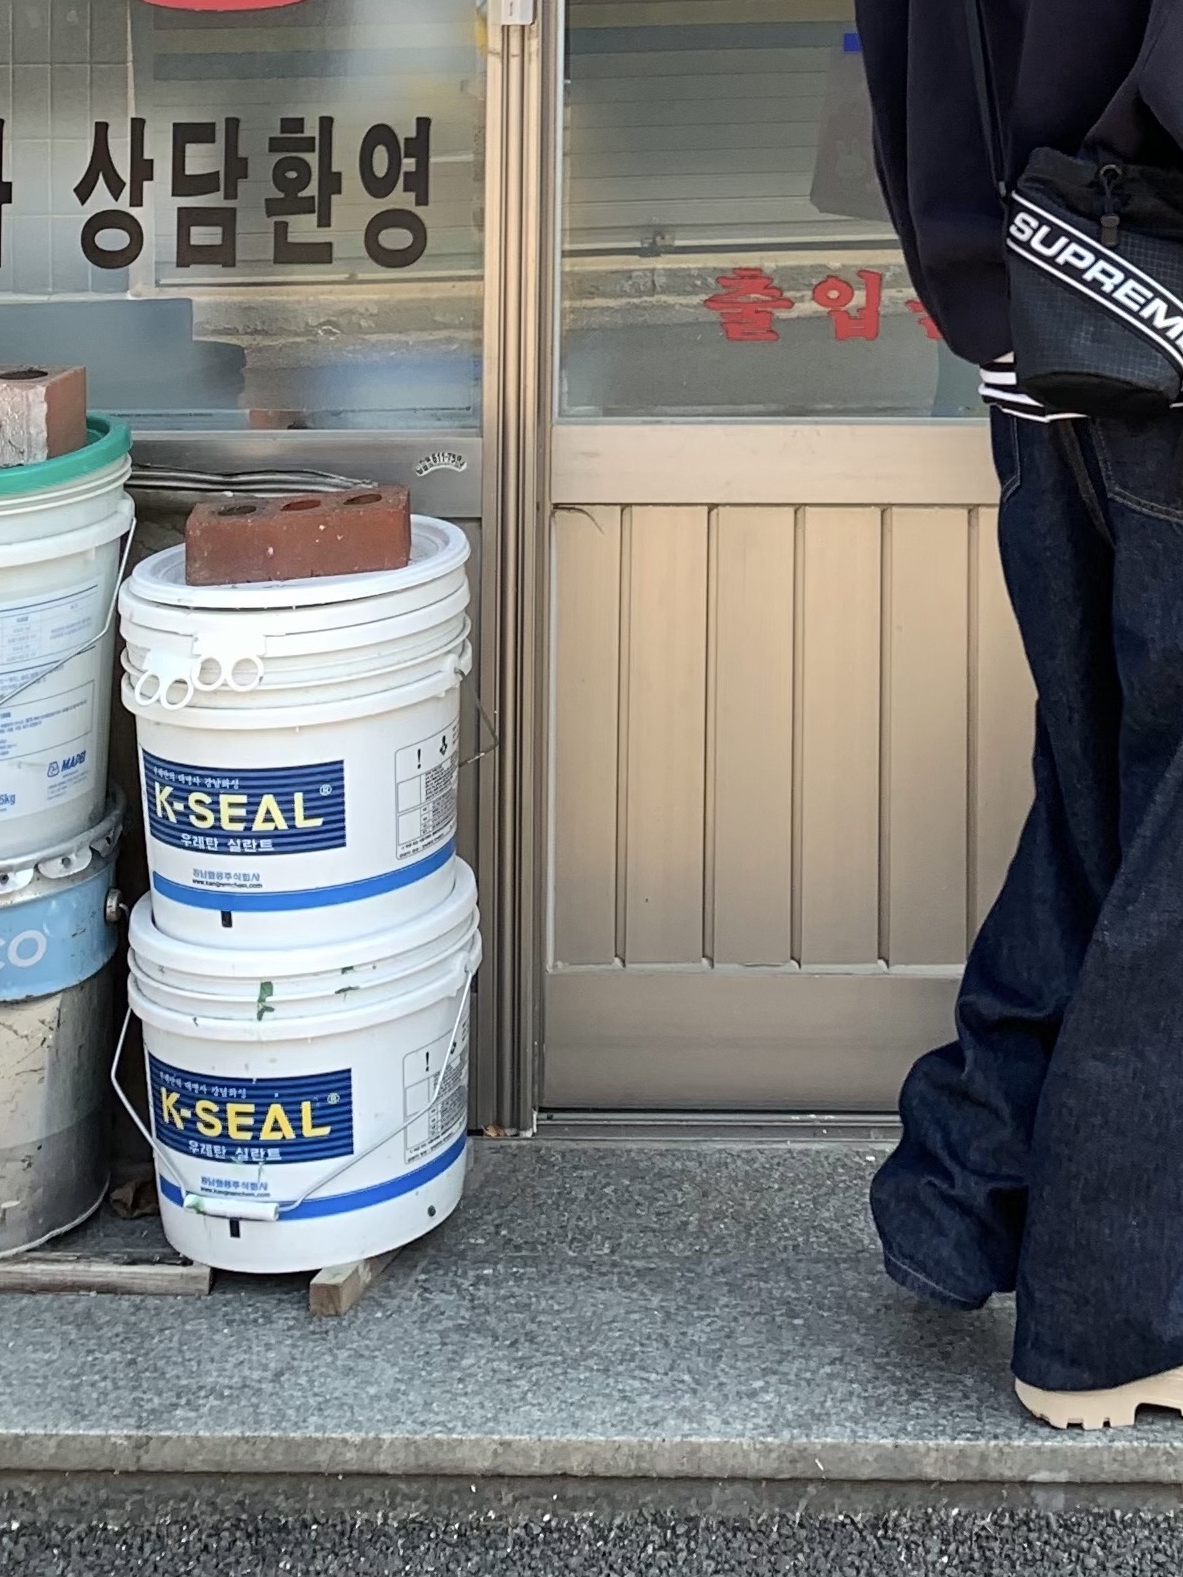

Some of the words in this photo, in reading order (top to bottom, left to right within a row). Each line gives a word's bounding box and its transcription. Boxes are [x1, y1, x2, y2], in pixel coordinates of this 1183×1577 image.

[73, 116, 432, 270] 상담환영
[703, 267, 944, 341] 출입
[154, 780, 324, 832] K-SEAL
[181, 833, 218, 851] 우레탄
[227, 837, 275, 853] 실란트
[0, 929, 47, 969] O
[160, 1086, 332, 1141] K-SEAL
[188, 1139, 226, 1158] 우레탄
[235, 1146, 282, 1161] 실란트
